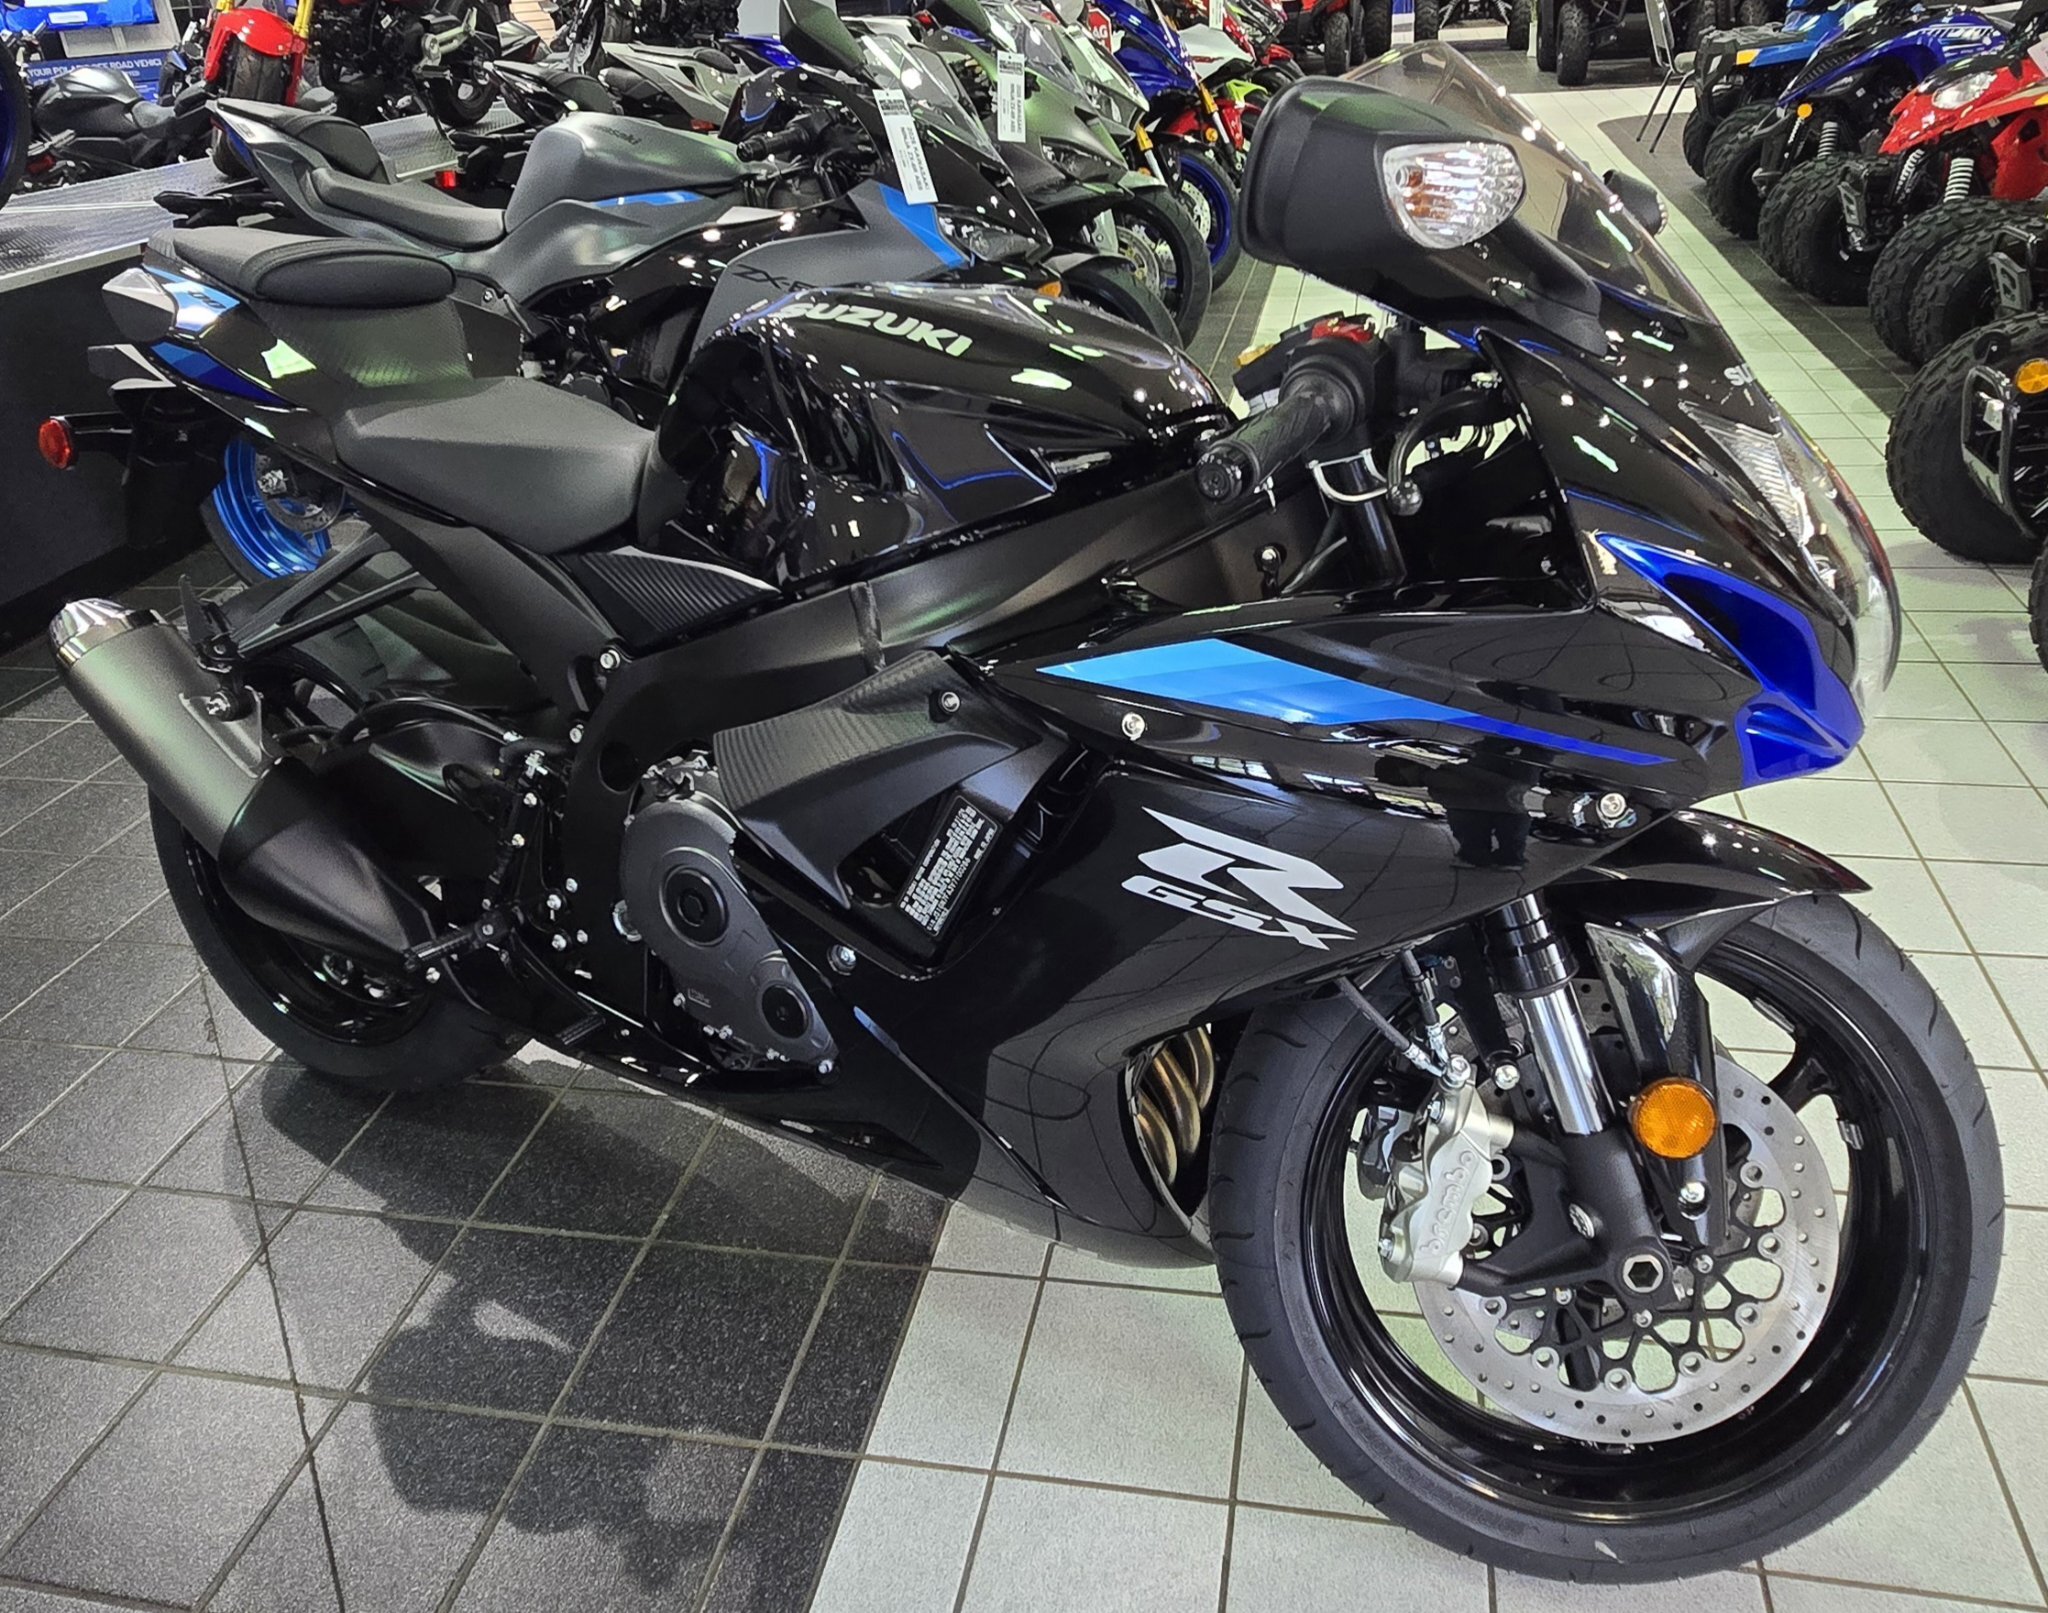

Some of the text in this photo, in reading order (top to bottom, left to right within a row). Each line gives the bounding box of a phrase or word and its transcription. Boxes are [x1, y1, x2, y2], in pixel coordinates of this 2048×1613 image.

[28, 68, 53, 77] YOUR
[769, 303, 973, 357] SUZUKI
[1138, 806, 1358, 934] R
[1121, 875, 1356, 951] GSX
[1419, 1150, 1478, 1256] brembo
